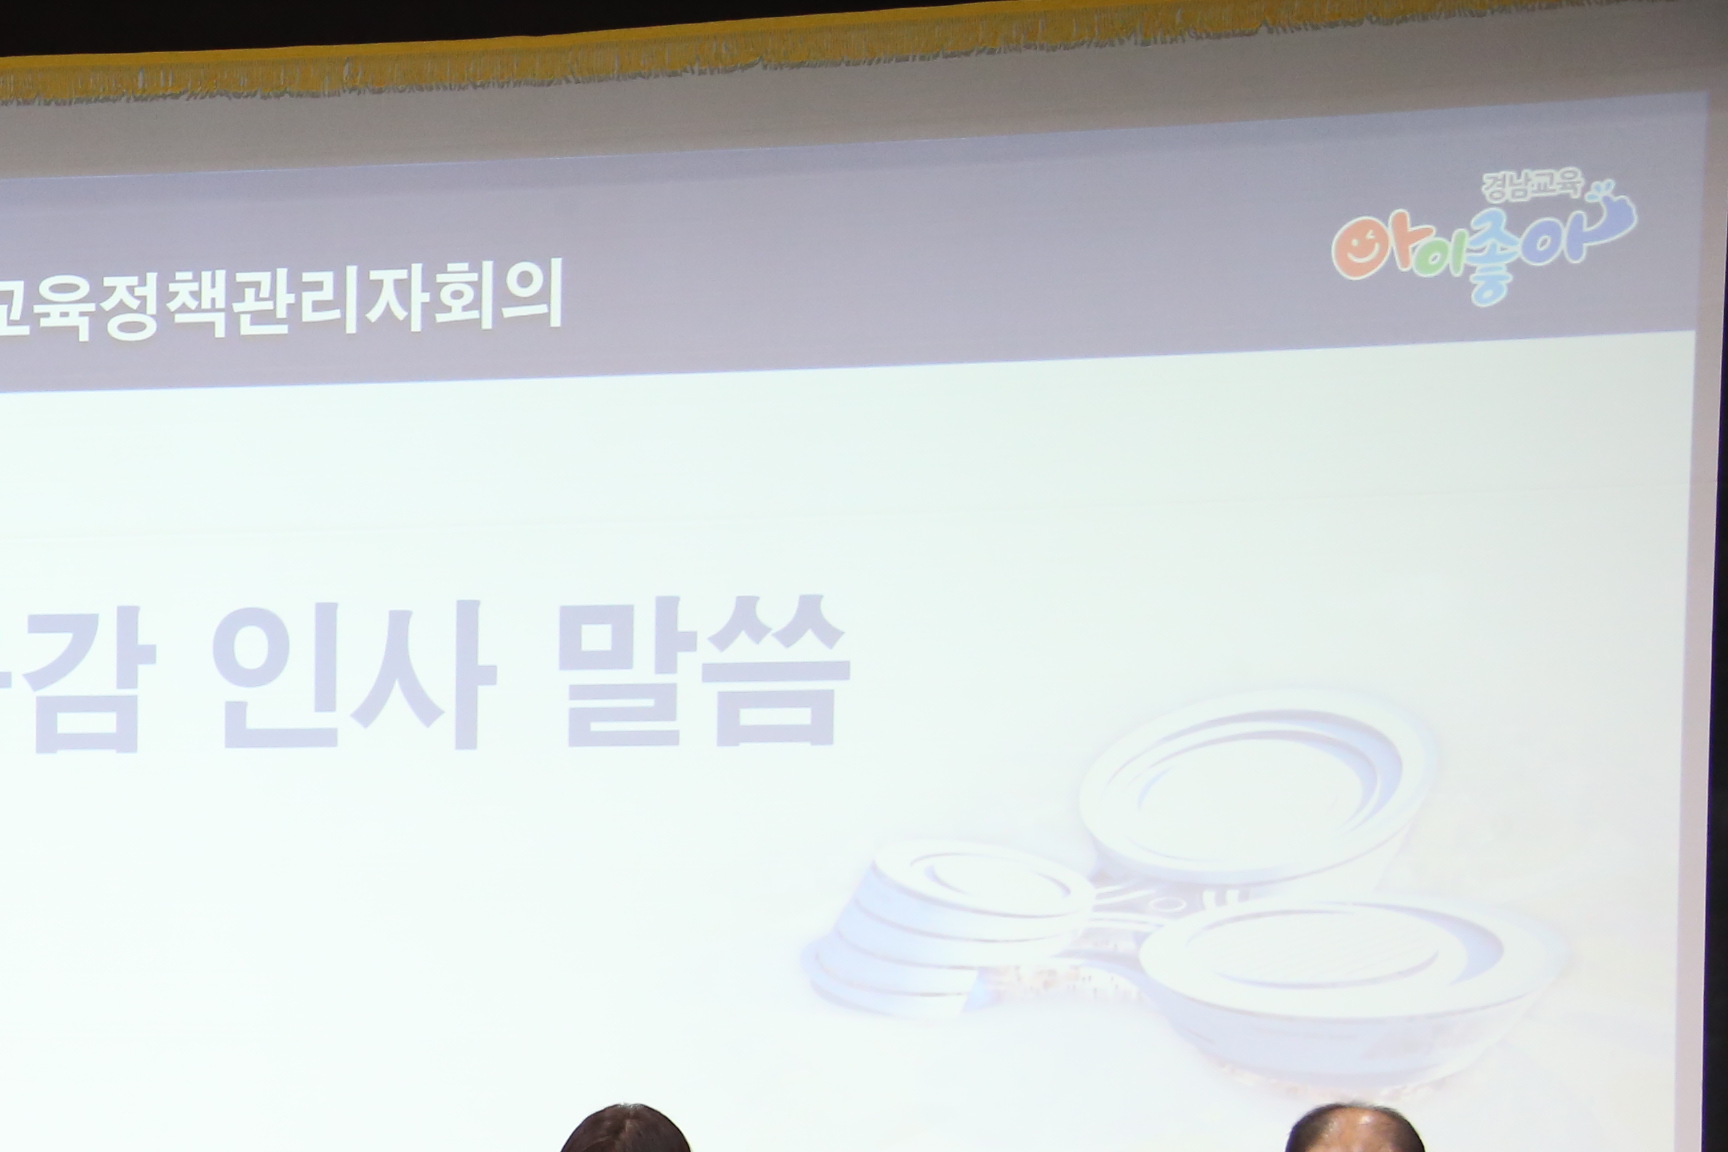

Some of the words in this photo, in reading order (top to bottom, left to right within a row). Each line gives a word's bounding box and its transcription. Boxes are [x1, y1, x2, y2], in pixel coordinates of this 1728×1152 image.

[1482, 167, 1584, 204] 경남교육
[1332, 195, 1638, 308] 아이좋아
[212, 600, 498, 752] 인사
[557, 594, 852, 750] 말씀
